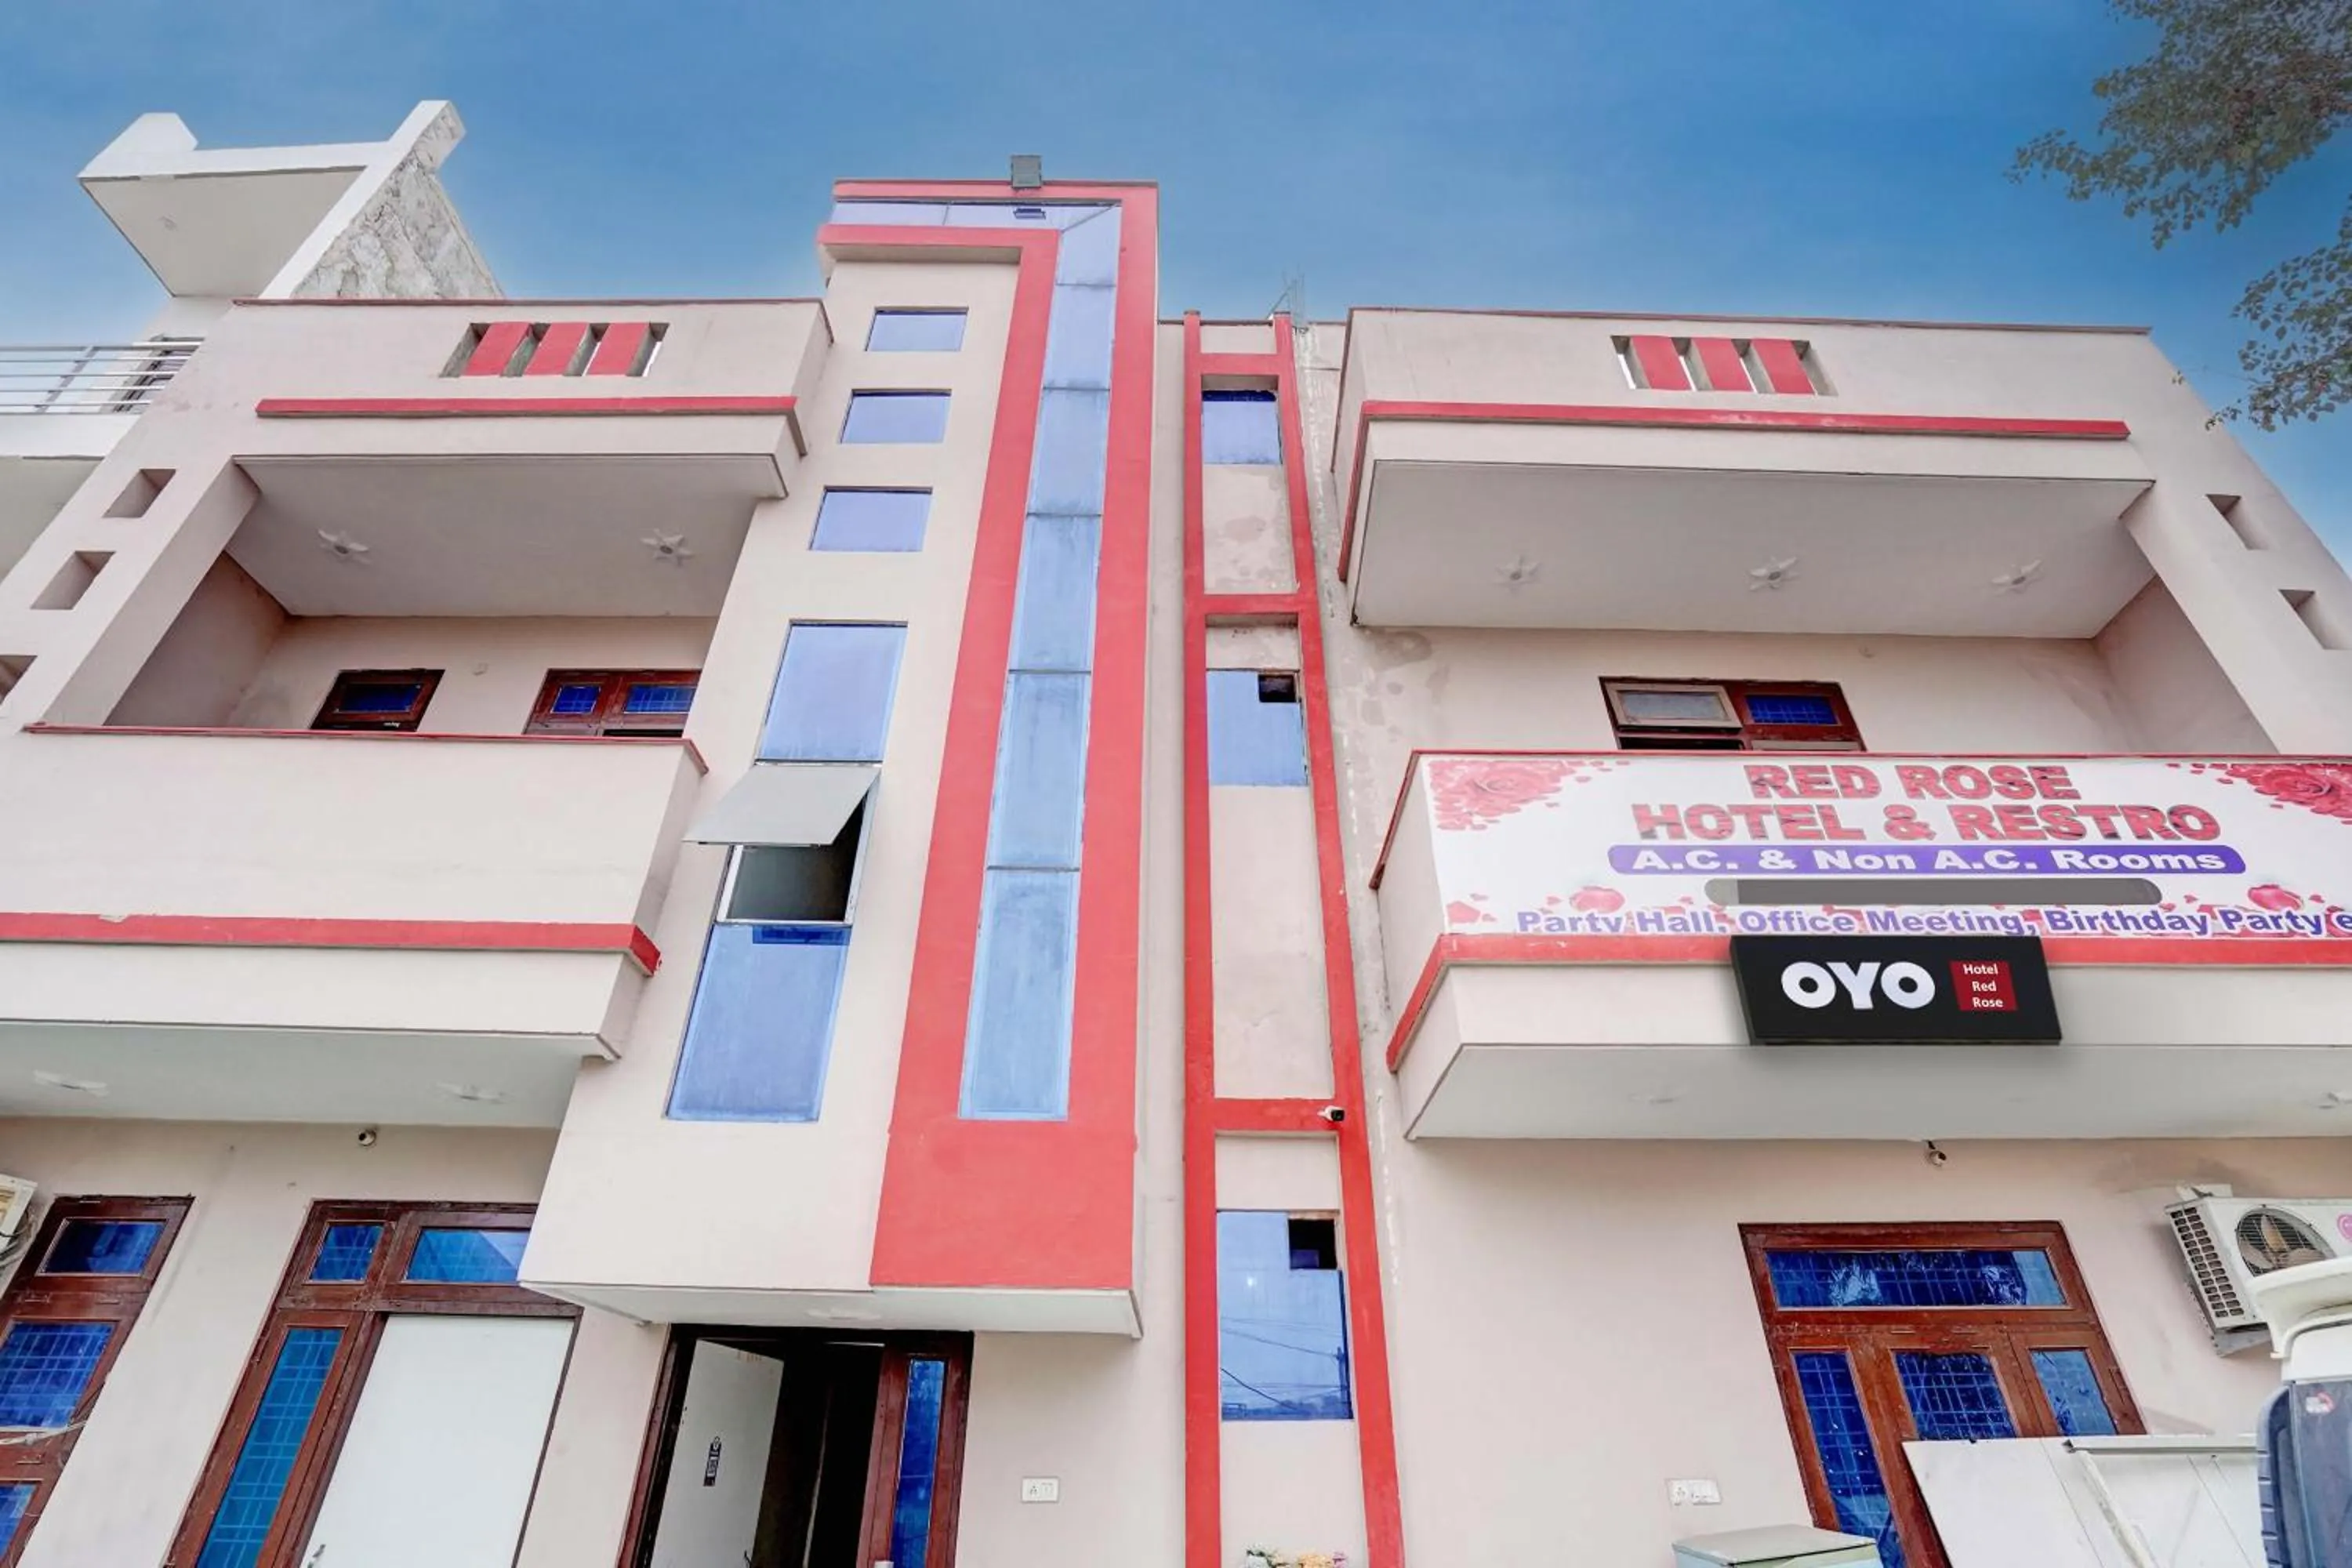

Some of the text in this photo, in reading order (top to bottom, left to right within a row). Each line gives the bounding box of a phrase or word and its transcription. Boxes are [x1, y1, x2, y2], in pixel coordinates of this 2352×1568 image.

[1744, 764, 2082, 800] RED ROSE
[1632, 804, 2221, 840] HOTEL & RESTRO
[1632, 849, 2227, 869] A.C. & Non A.C. Rooms
[1517, 912, 1624, 932] Party
[1740, 909, 1856, 932] Office
[1867, 909, 2038, 936] Meeting,
[2045, 909, 2208, 936] Birthday
[2220, 909, 2322, 935] Party
[1963, 963, 1998, 975] Hotel
[1781, 961, 1935, 1009] OYO
[1973, 980, 1997, 992] Red
[1973, 996, 2003, 1007] Rose
